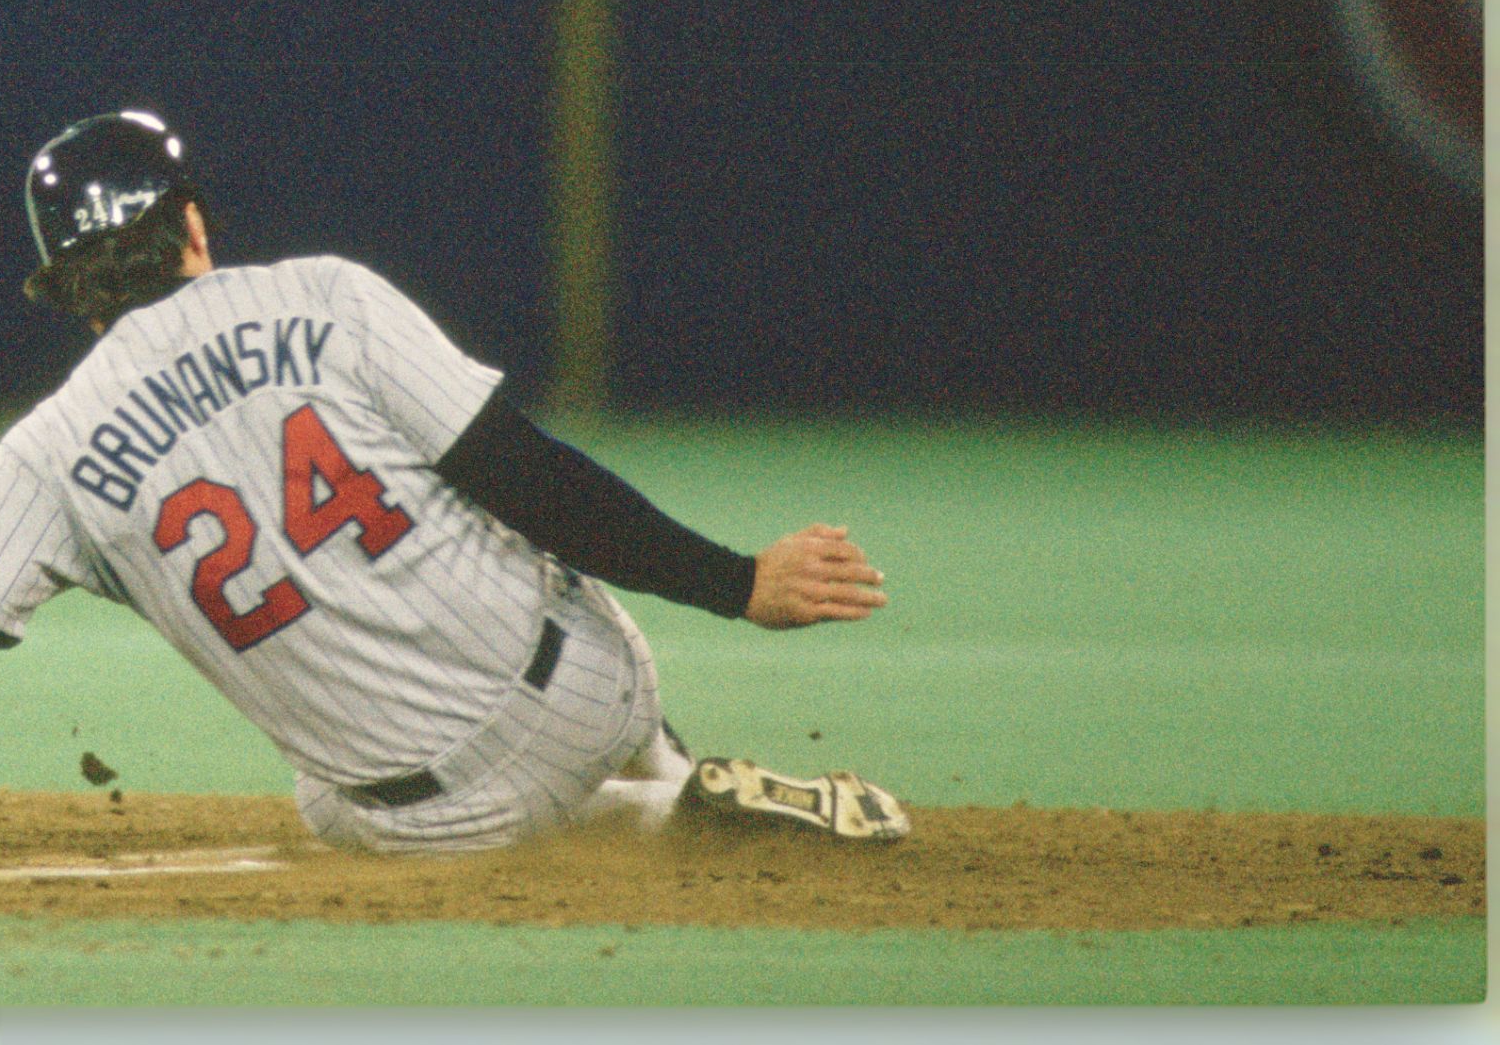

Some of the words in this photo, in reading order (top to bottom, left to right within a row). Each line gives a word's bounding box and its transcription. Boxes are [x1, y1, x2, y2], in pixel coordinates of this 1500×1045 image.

[74, 196, 108, 232] 24
[70, 317, 334, 513] BRUNANSKY
[152, 401, 415, 654] 24
